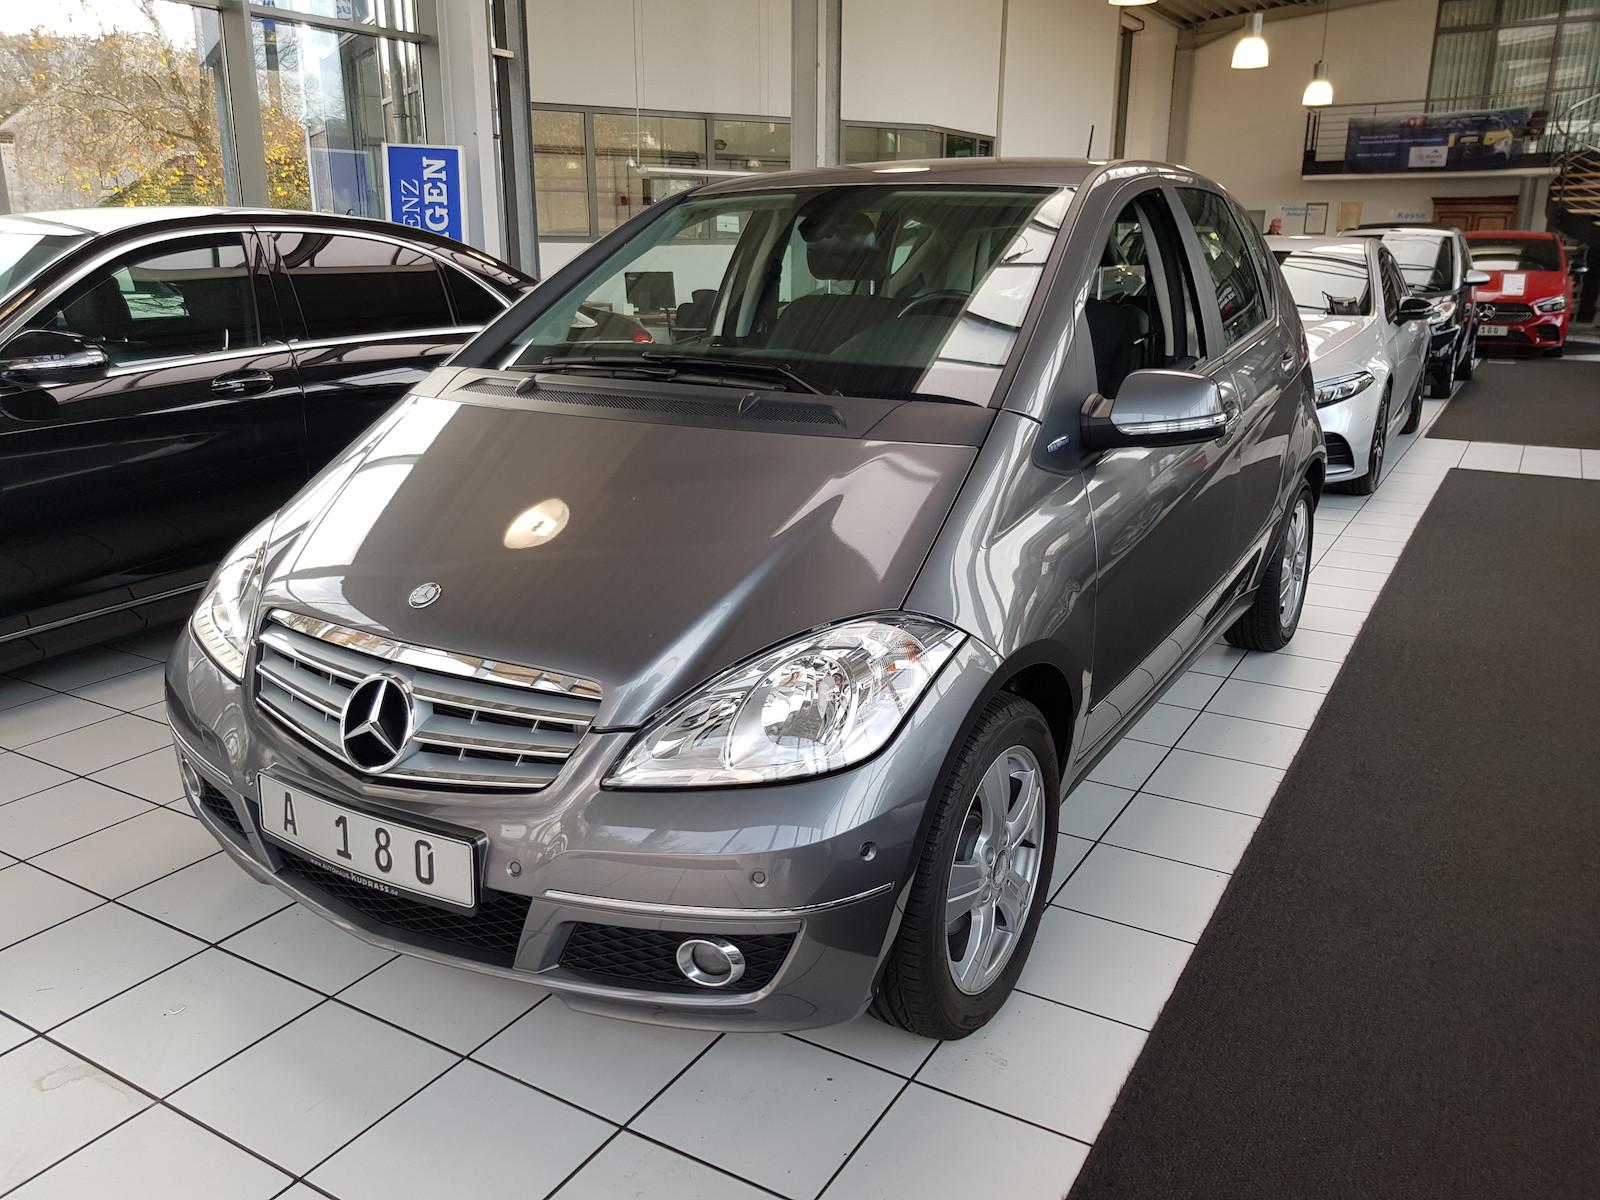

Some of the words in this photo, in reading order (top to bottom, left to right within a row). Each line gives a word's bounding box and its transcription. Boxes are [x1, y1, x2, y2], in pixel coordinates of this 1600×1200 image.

[422, 156, 450, 238] GEN
[283, 791, 298, 837] A
[335, 815, 435, 885] 180
